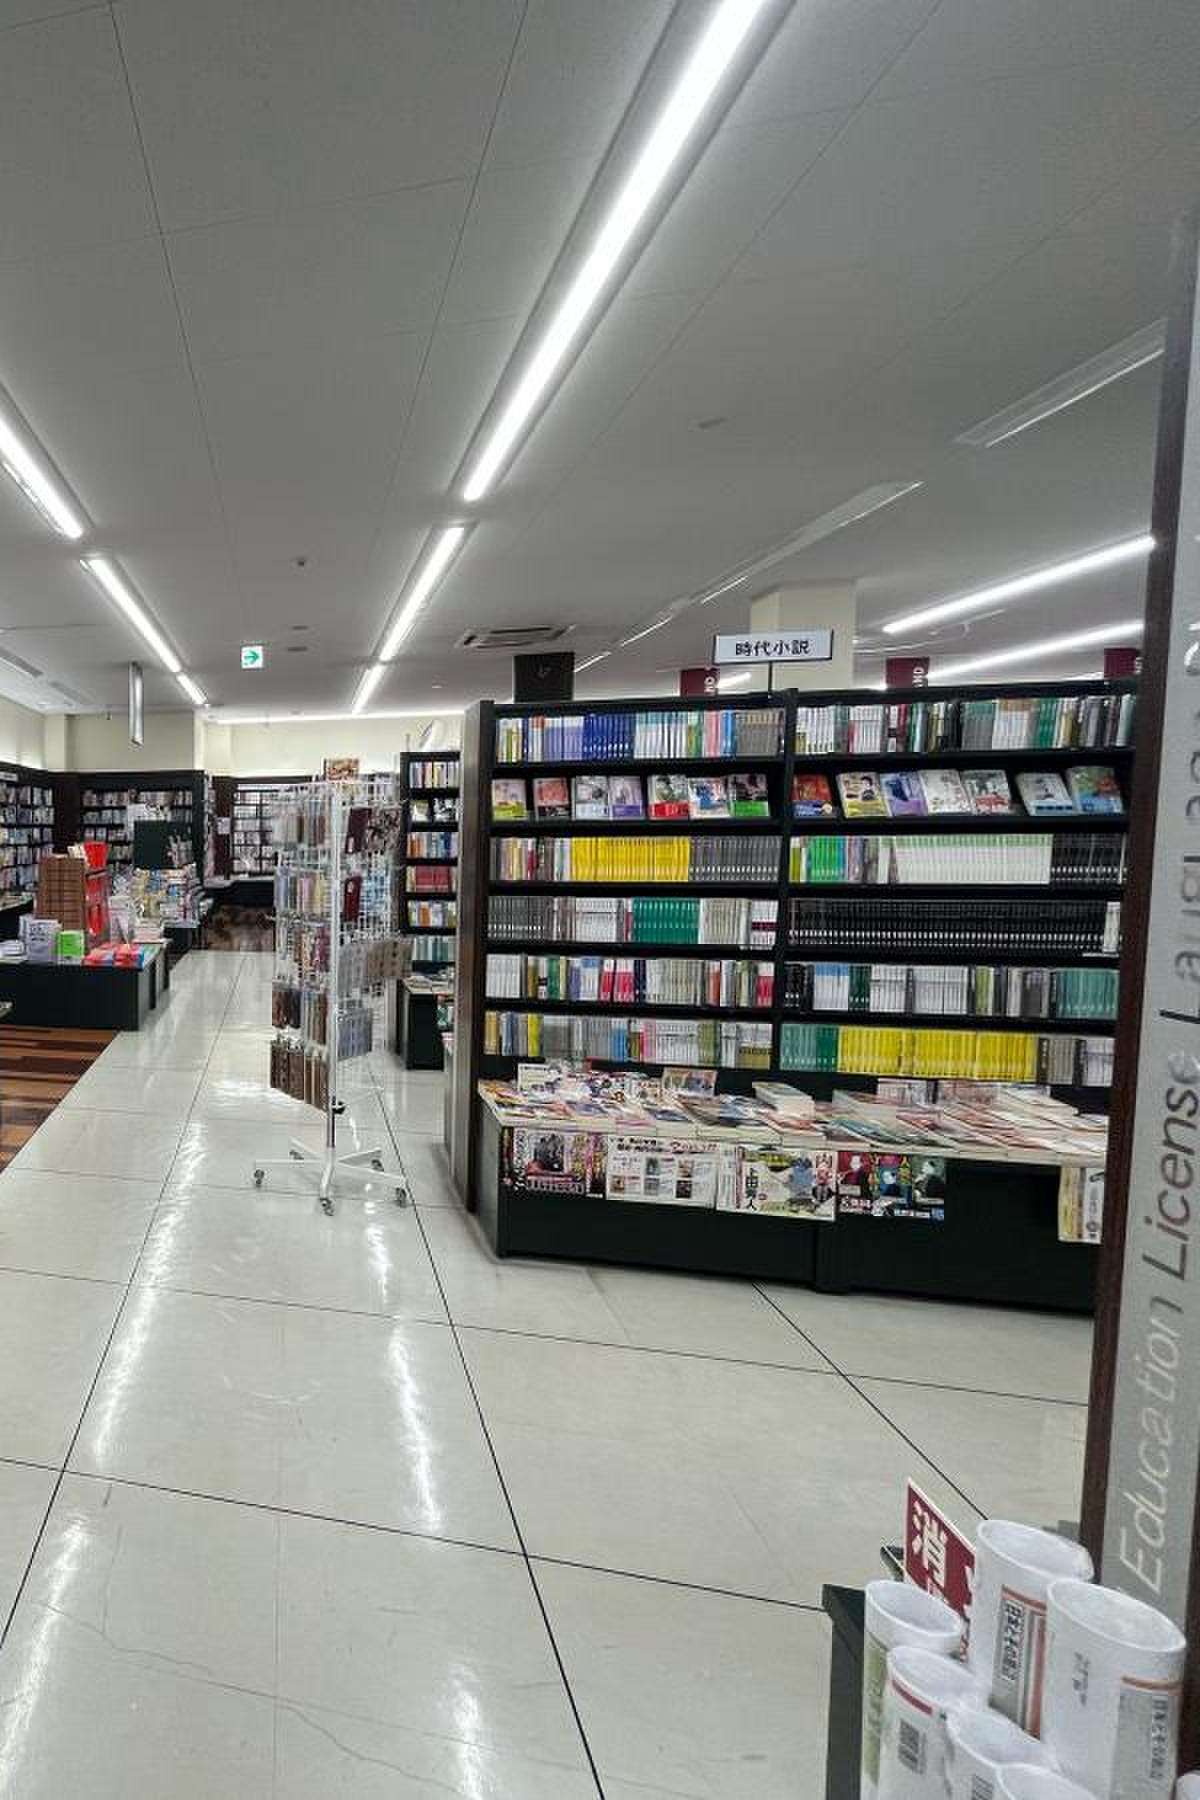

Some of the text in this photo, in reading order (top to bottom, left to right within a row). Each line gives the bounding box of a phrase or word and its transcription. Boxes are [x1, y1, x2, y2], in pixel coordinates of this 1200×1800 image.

[735, 639, 811, 657] 時代小説
[1142, 1049, 1200, 1281] License
[1120, 1295, 1185, 1594] Education
